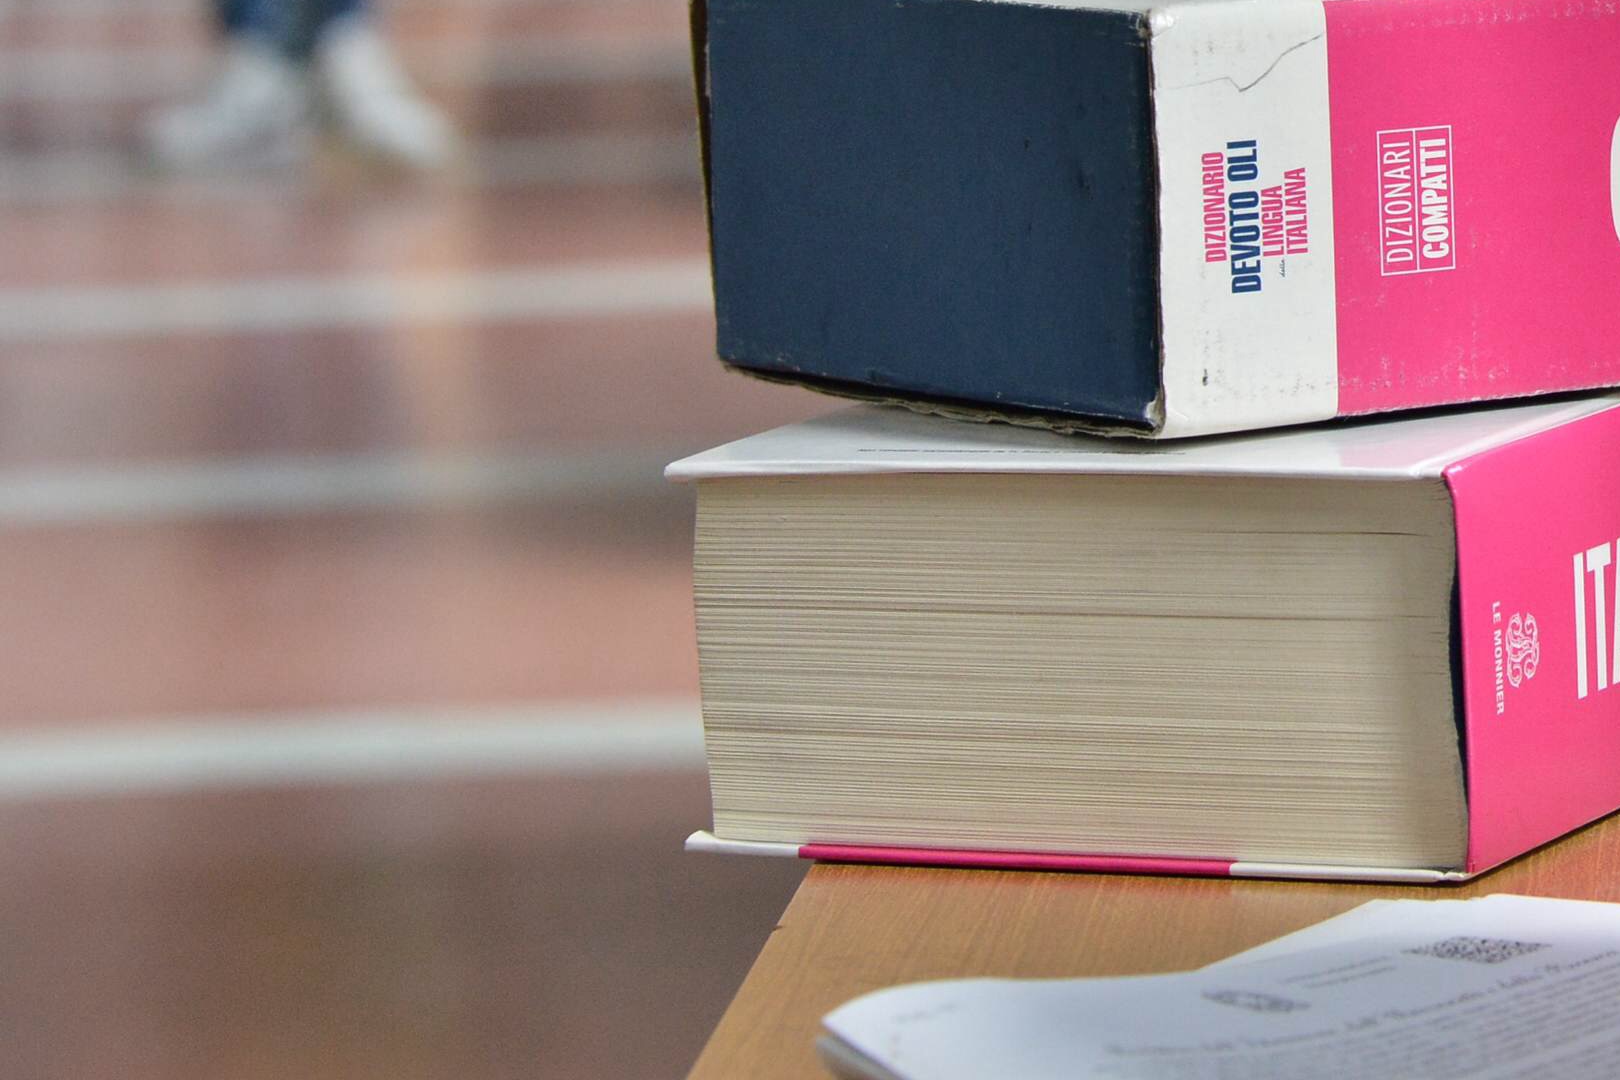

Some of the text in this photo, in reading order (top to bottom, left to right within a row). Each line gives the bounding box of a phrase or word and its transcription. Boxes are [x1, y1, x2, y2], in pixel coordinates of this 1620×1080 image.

[1201, 151, 1228, 263] DIZIONARIO
[1226, 139, 1262, 294] DEVOTO OLI
[1260, 185, 1285, 258] LINGUA
[1284, 167, 1309, 255] ITALIANA
[1382, 141, 1414, 263] DIZIONARI
[1419, 138, 1450, 260] COMPATTI
[1492, 600, 1505, 716] LE MONNIER
